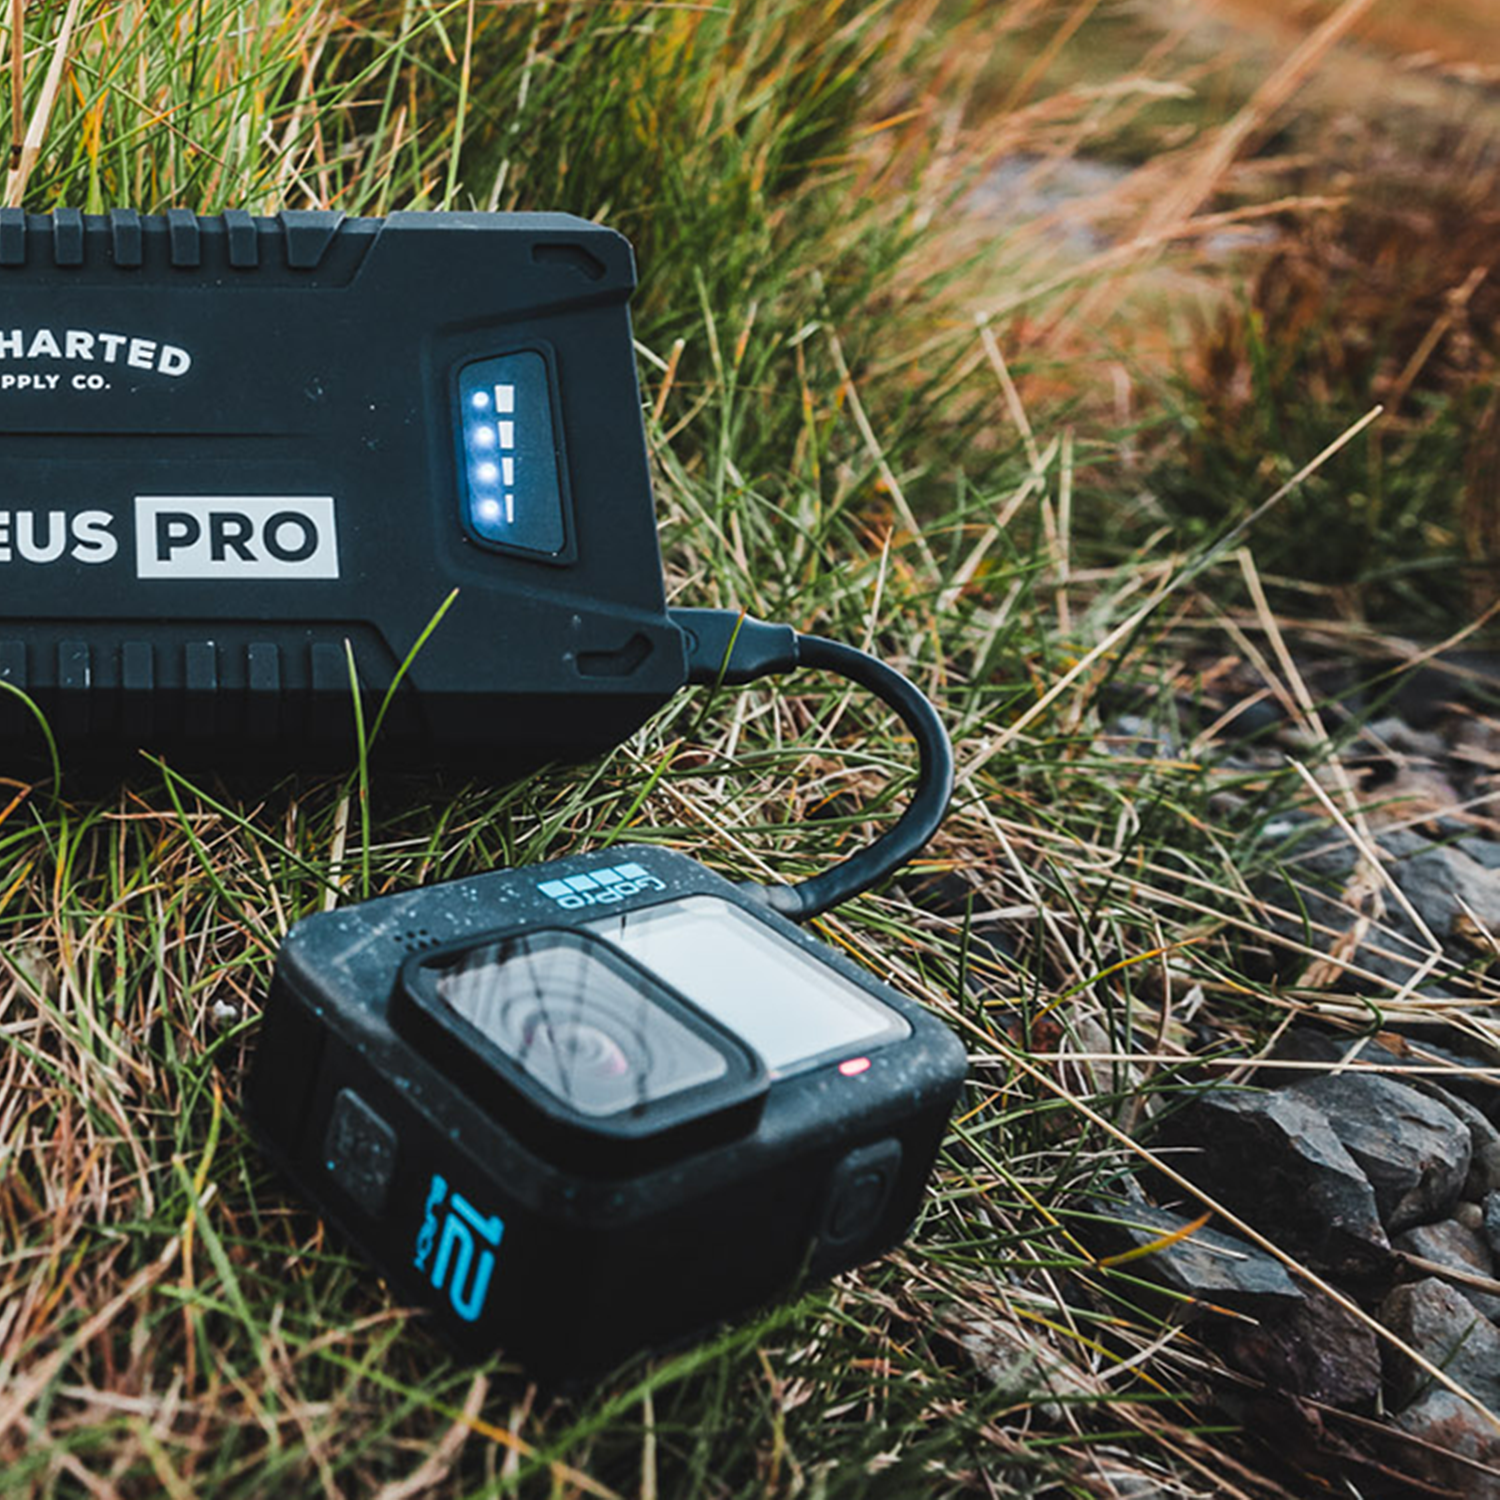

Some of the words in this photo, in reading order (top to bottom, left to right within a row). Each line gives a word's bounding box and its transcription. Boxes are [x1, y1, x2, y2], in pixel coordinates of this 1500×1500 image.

[71, 374, 111, 390] CO.
[155, 511, 319, 563] PRO
[556, 875, 667, 909] GoPro
